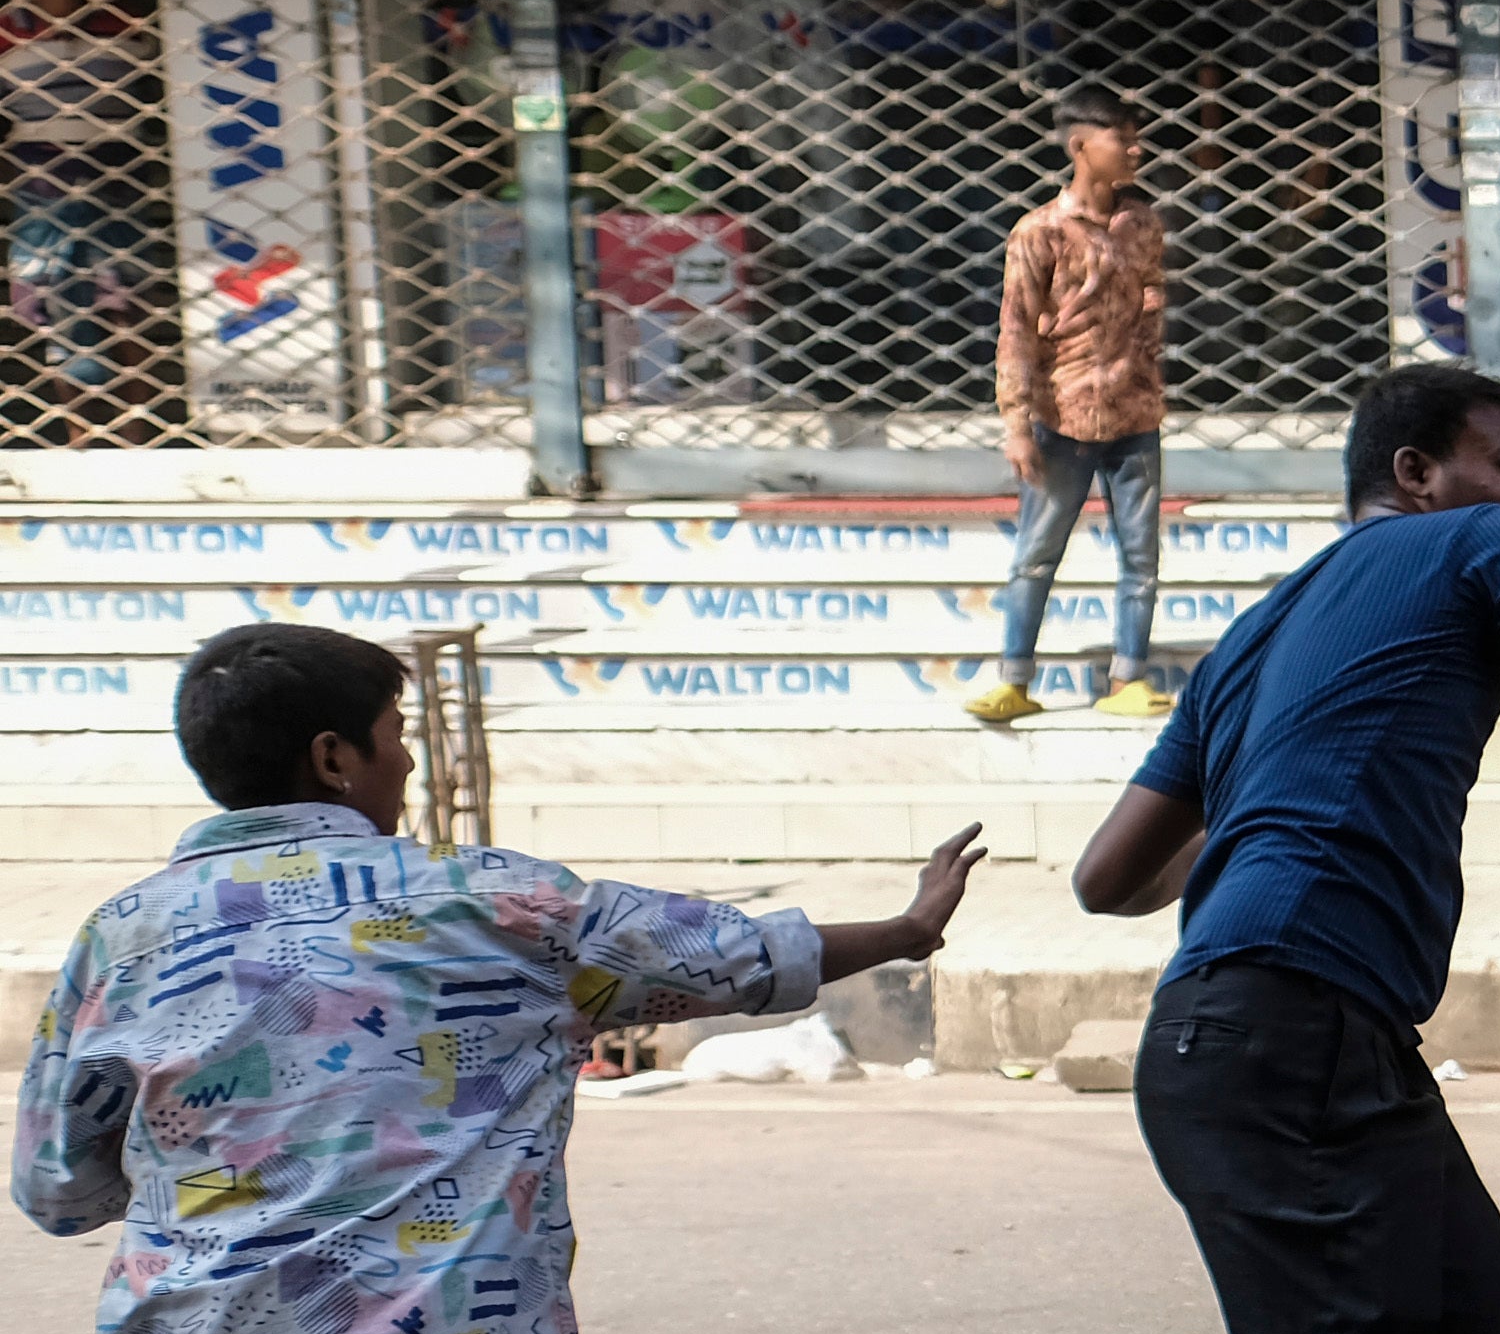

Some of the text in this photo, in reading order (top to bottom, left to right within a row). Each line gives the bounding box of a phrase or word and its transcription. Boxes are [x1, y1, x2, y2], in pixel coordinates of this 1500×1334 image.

[61, 522, 266, 553] WALTON
[408, 523, 610, 554] WALTON
[749, 523, 950, 553] WALTON
[334, 589, 540, 623] WALTON
[684, 589, 889, 623] WALTON
[641, 665, 851, 696] WALTON
